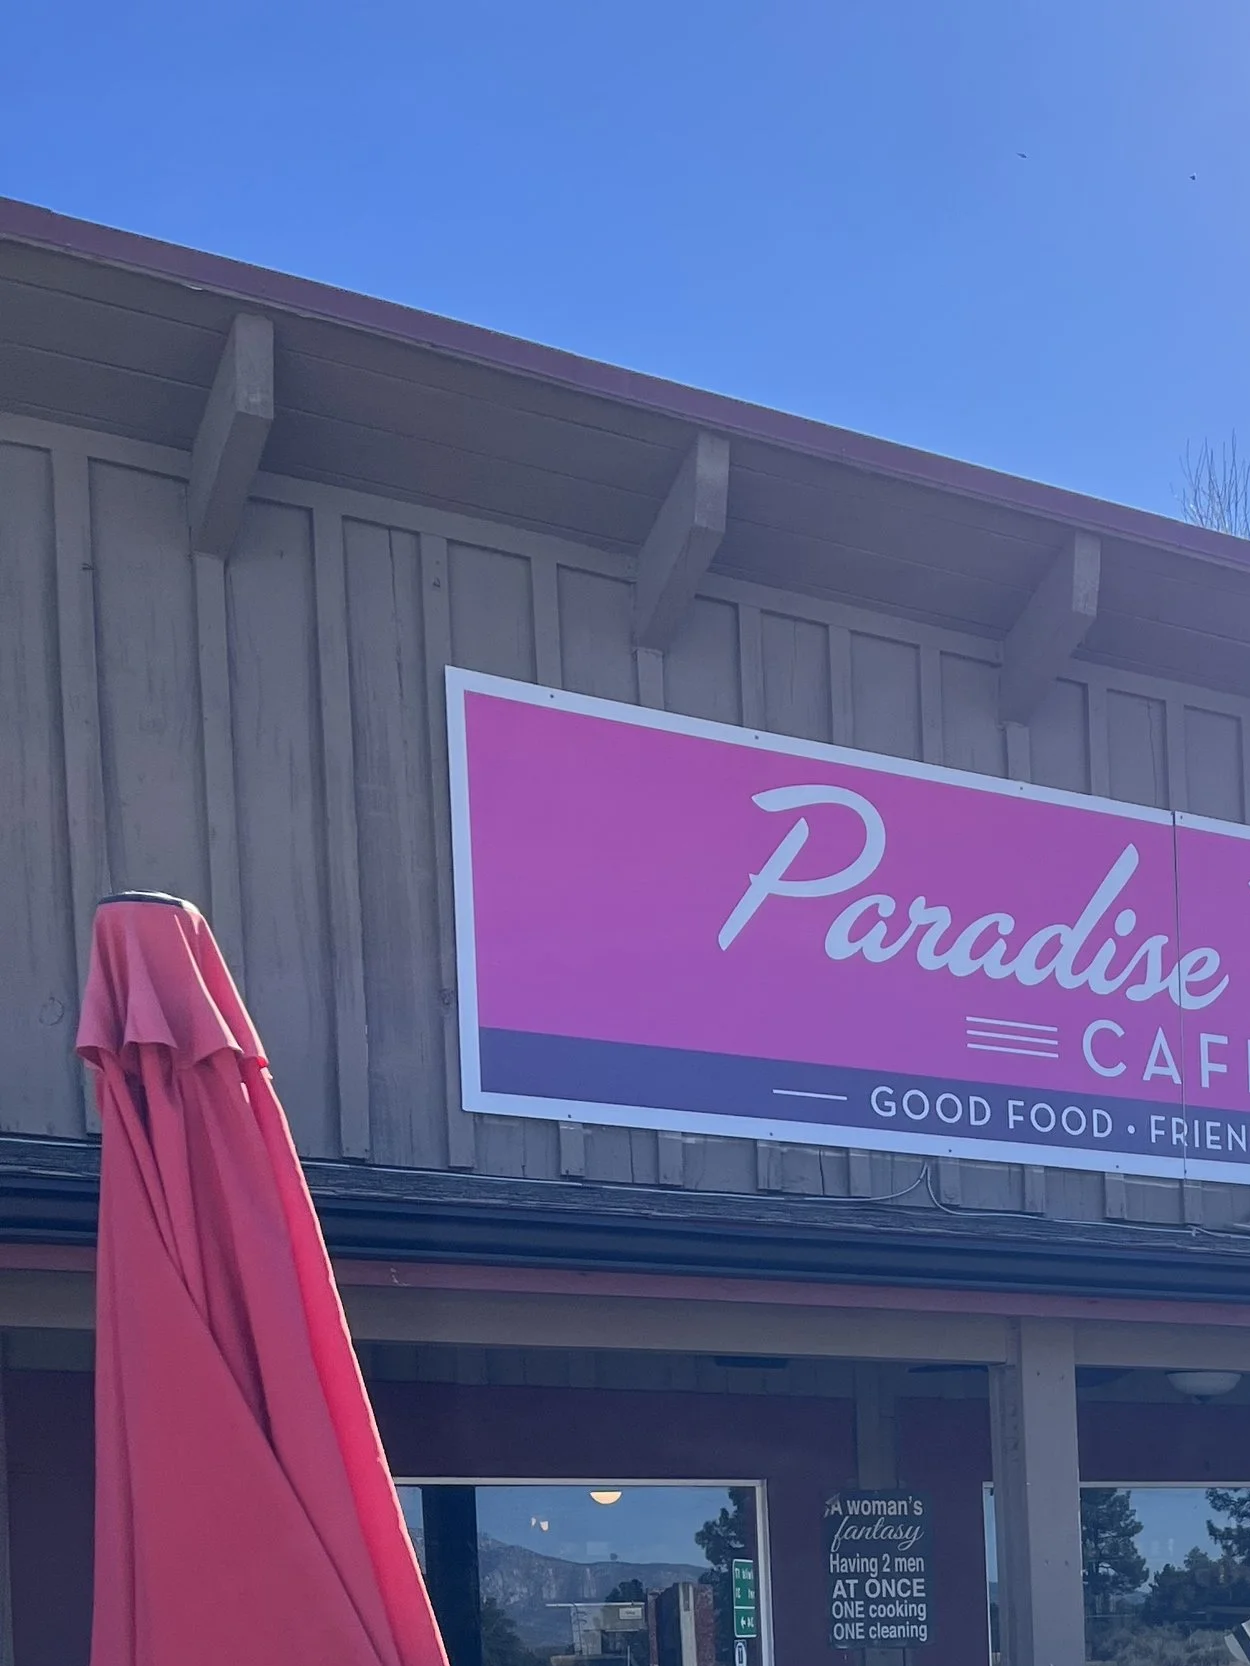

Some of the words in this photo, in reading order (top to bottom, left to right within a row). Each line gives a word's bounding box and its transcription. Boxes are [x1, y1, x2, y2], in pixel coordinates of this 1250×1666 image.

[718, 784, 1230, 1011] Paradise
[870, 1086, 991, 1126] GOOD
[1008, 1099, 1113, 1138] FOOD
[831, 1499, 842, 1516] A
[847, 1495, 924, 1516] woman's
[830, 1515, 925, 1553] fantasy
[829, 1553, 879, 1577] Having
[882, 1553, 891, 1573] 2
[895, 1556, 925, 1573] men
[832, 1579, 859, 1599] AT
[865, 1578, 926, 1598] ONCE
[832, 1601, 865, 1619] ONE
[869, 1599, 927, 1621] cooking
[833, 1622, 865, 1640] ONE
[869, 1621, 928, 1642] cleaning
